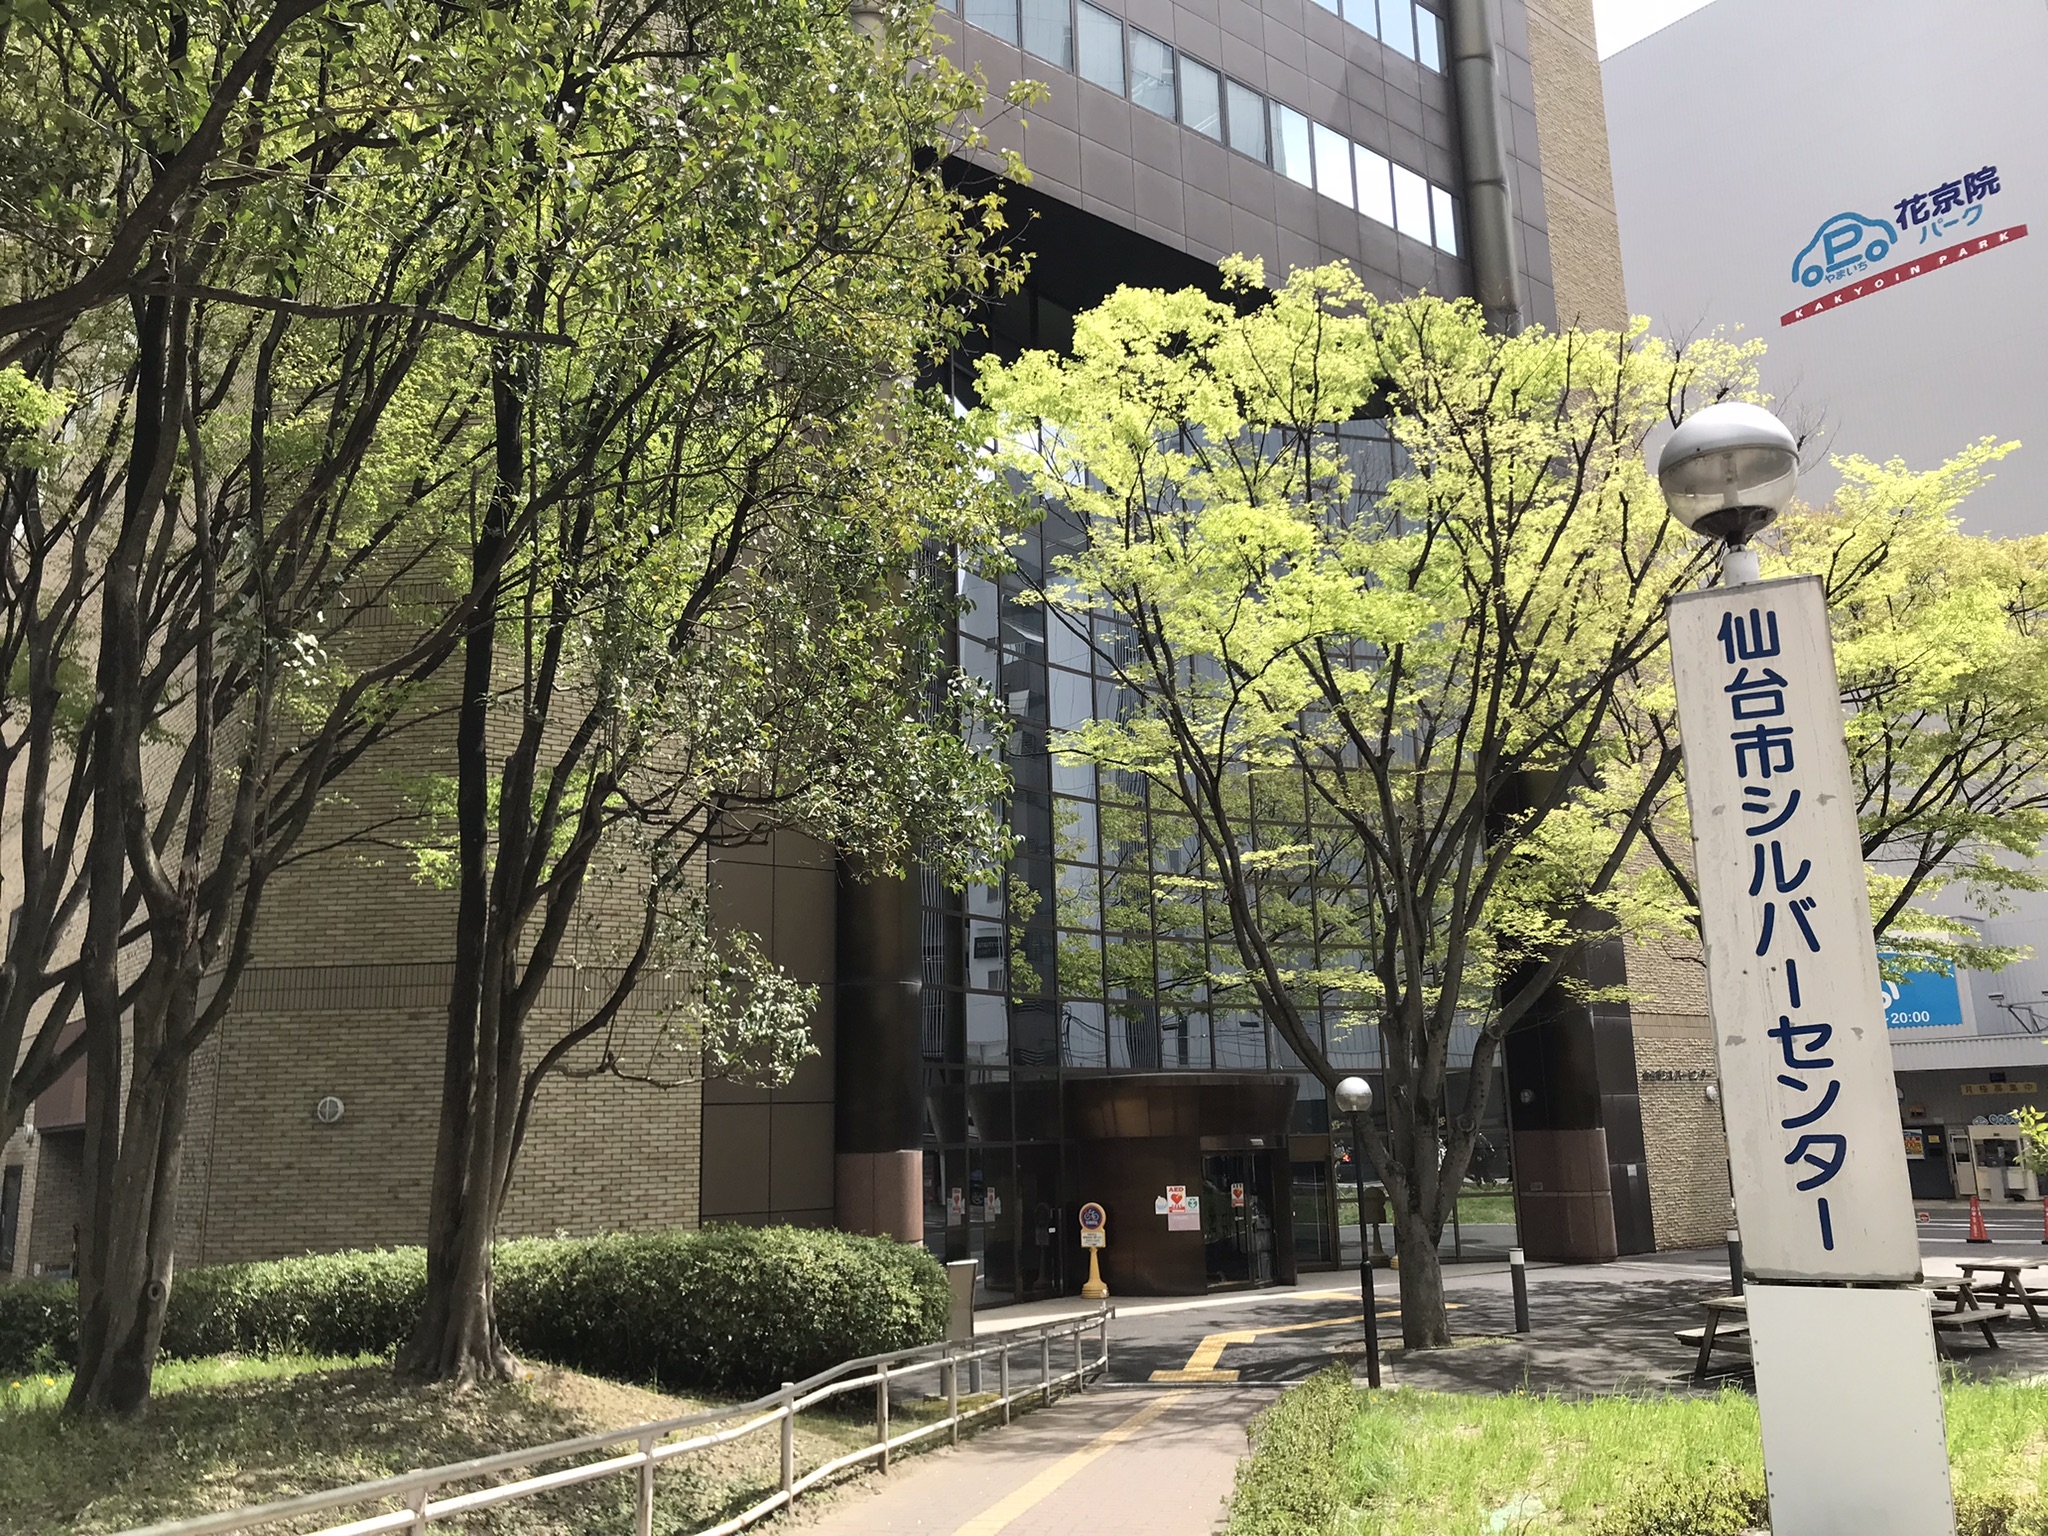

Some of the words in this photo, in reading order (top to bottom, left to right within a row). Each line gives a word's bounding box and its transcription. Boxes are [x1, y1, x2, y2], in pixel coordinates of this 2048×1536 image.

[1894, 165, 2001, 231] 花京院
[1919, 203, 1983, 245] パーク
[1794, 264, 1921, 319] KAKYOIN
[1938, 231, 2010, 265] PARK
[1824, 260, 1868, 284] やまいち
[1716, 608, 1847, 1252] 仙台市シルバーセンター
[1890, 1010, 1930, 1024] 20:00
